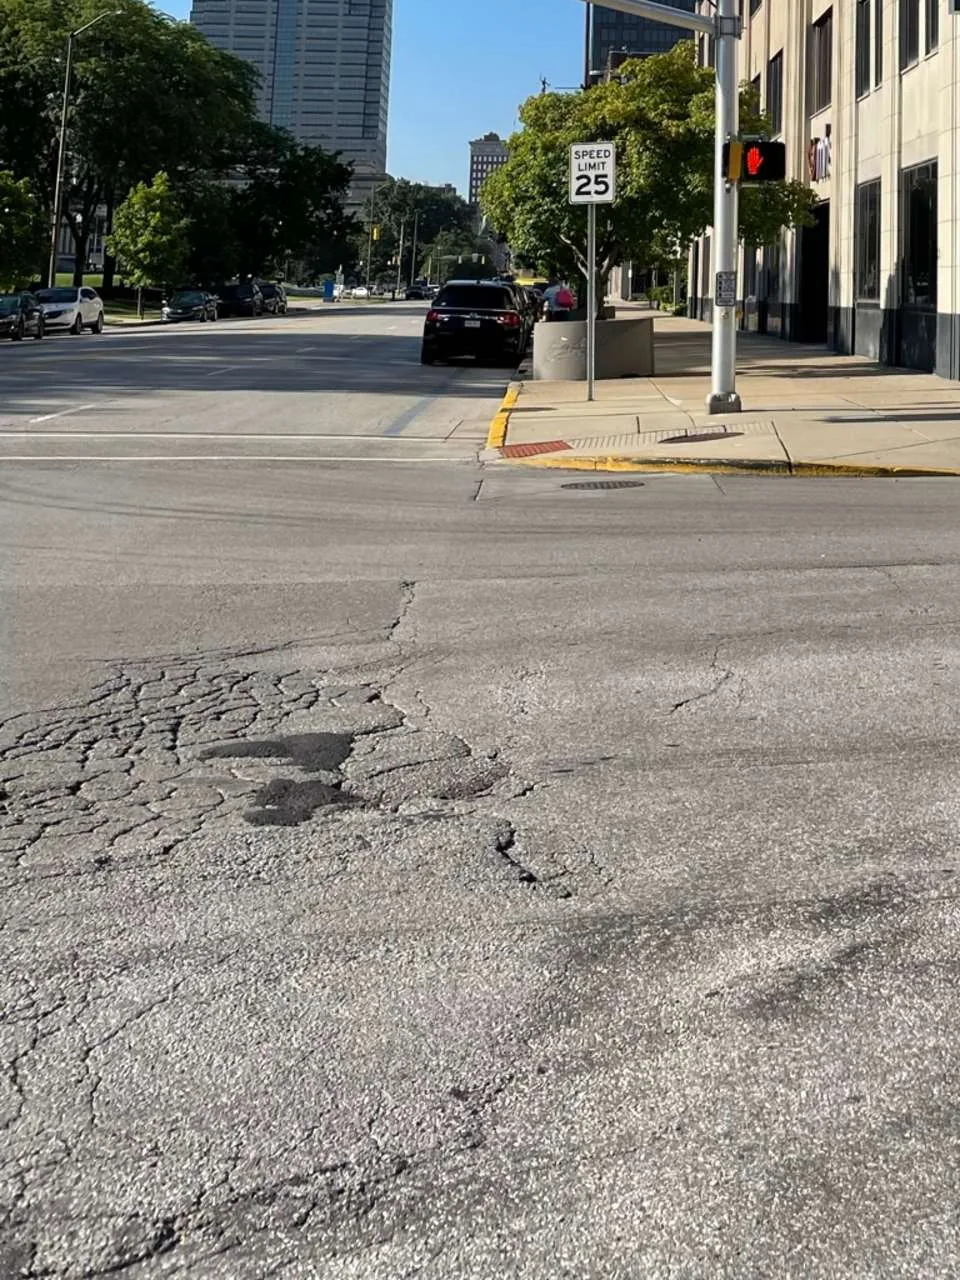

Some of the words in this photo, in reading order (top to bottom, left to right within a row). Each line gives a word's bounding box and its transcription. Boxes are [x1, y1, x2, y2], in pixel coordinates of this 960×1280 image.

[574, 150, 611, 160] SPEED
[578, 161, 606, 171] LIMIT
[575, 174, 609, 195] 25
